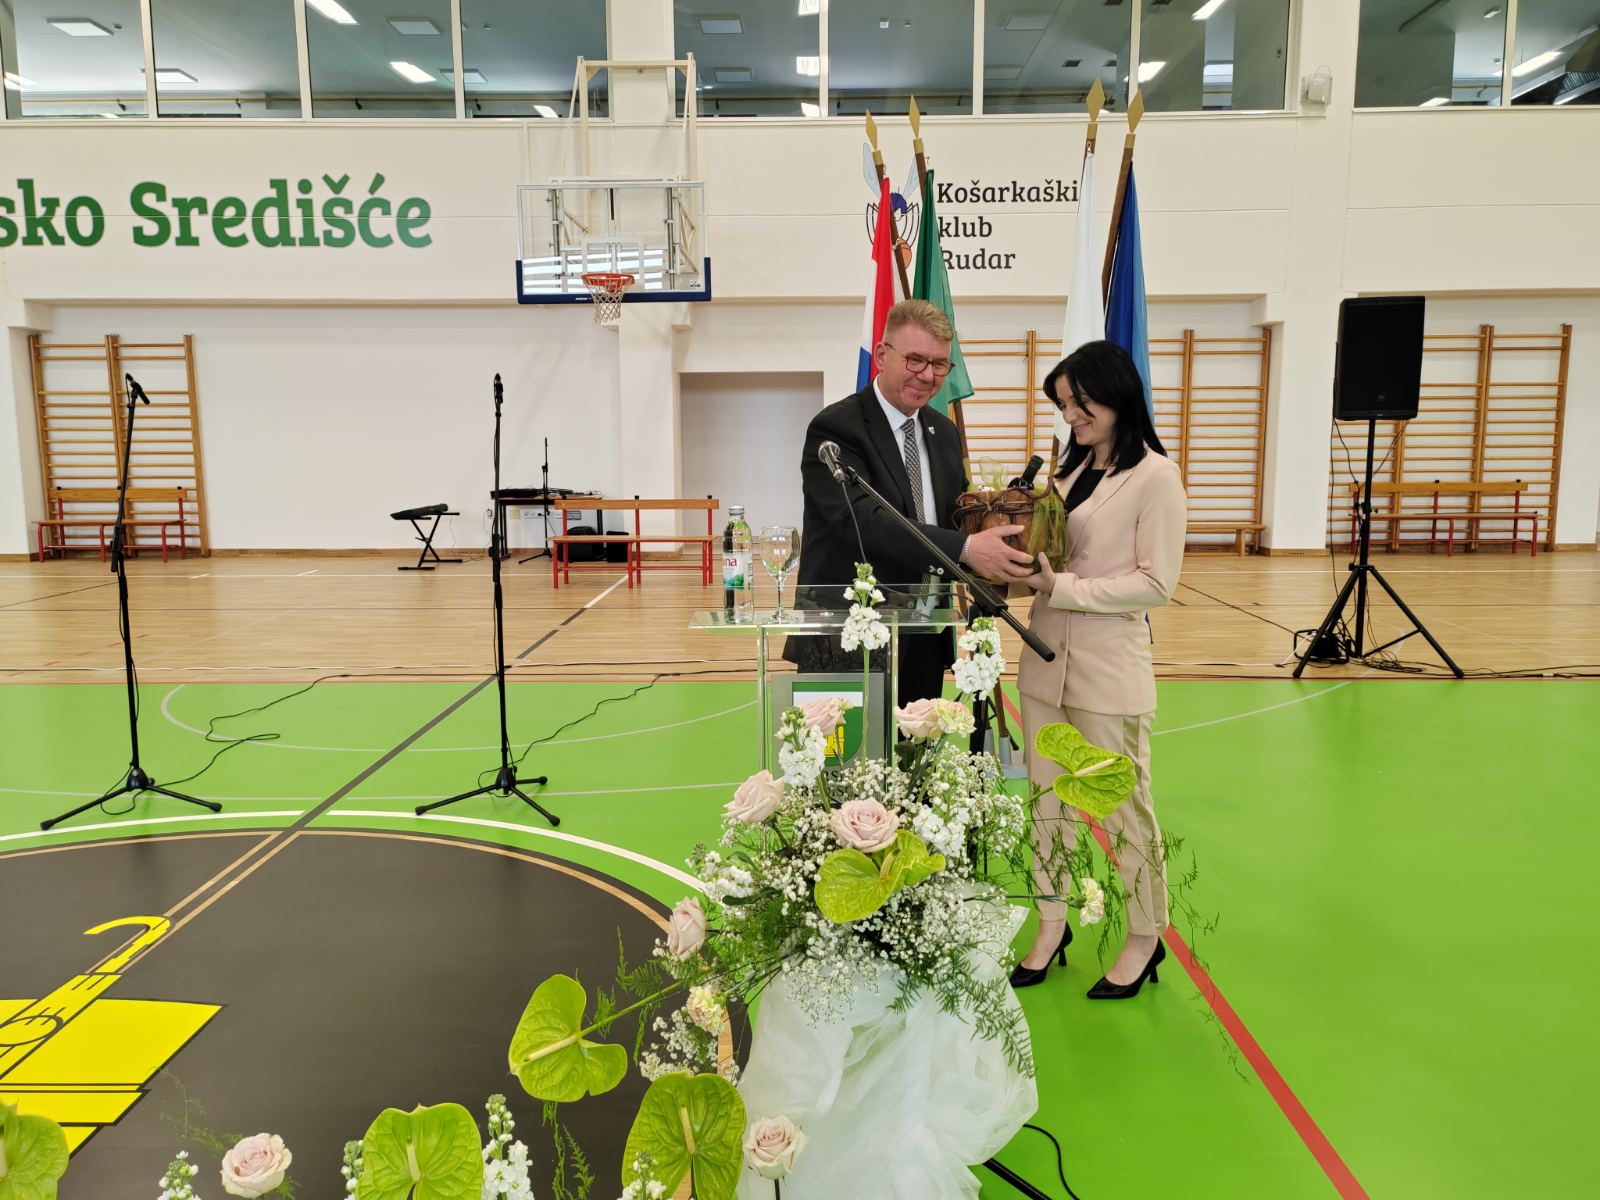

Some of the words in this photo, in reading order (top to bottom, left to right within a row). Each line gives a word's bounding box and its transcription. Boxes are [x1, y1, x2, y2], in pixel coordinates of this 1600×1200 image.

[936, 179, 1079, 204] Košarkaški
[129, 172, 433, 248] Središće
[938, 216, 993, 238] klub
[941, 248, 1017, 270] Rudar
